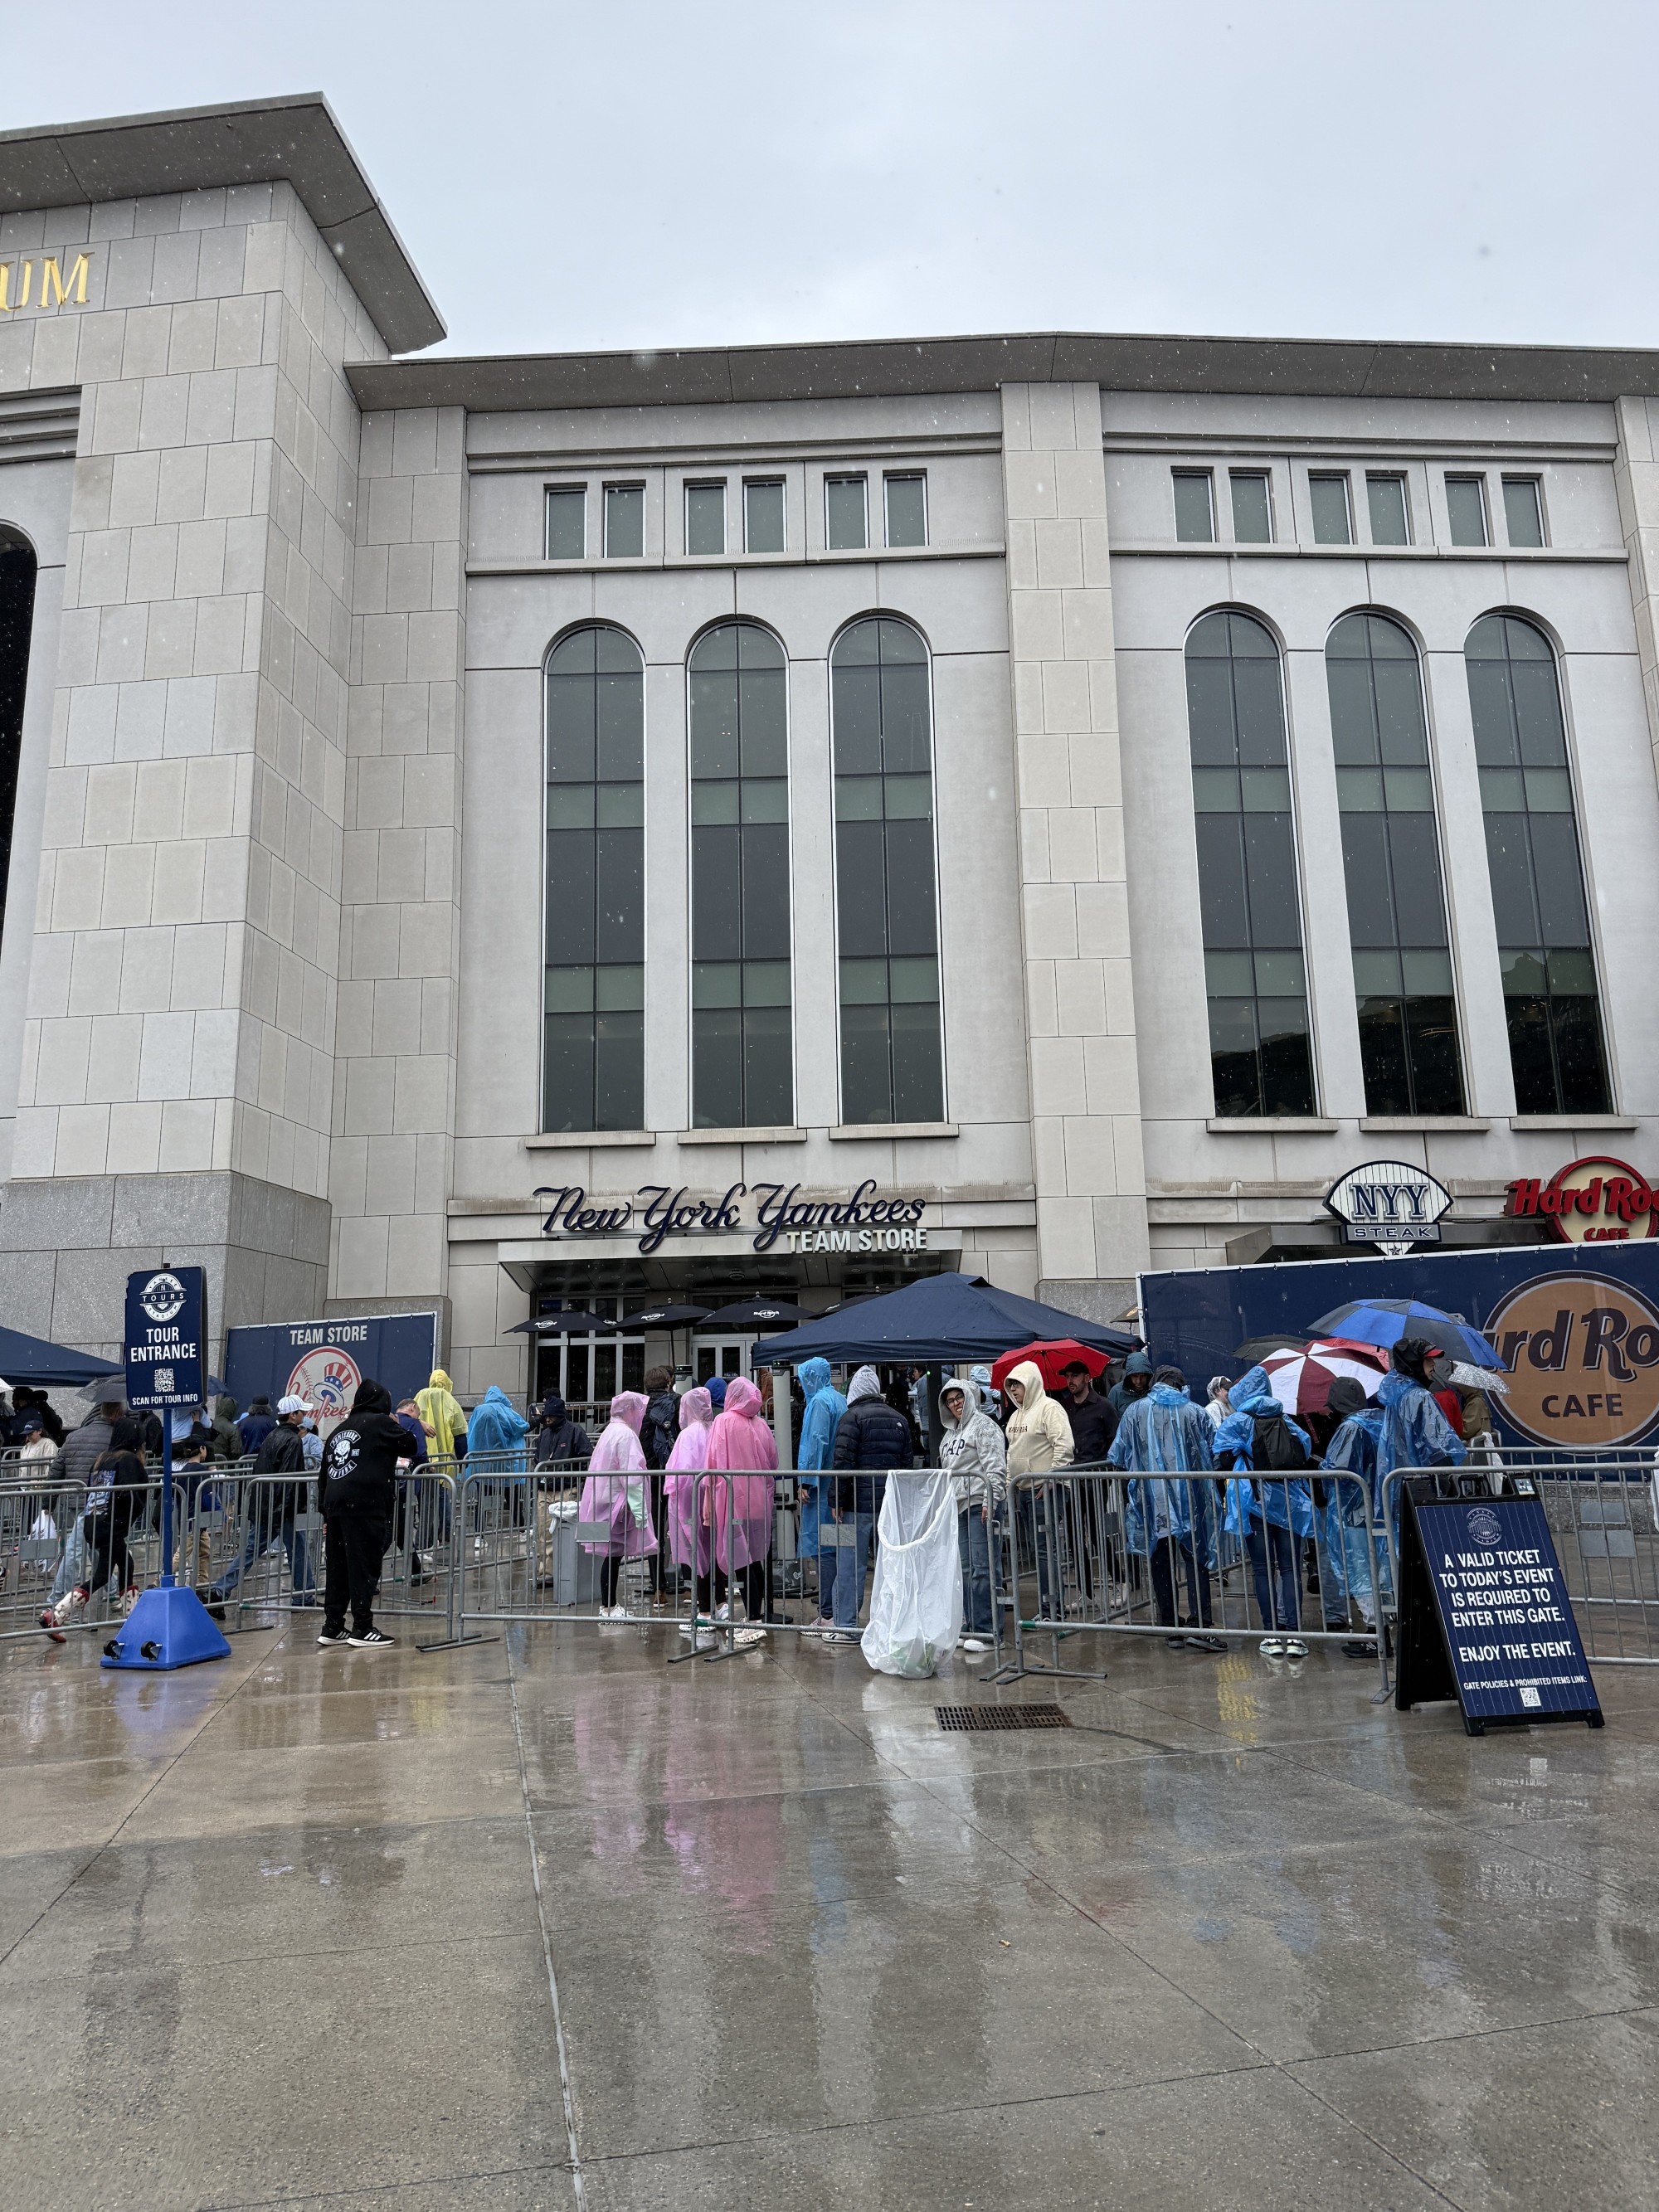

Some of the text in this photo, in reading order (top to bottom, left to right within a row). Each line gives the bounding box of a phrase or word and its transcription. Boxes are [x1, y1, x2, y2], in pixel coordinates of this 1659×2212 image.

[1349, 1182, 1429, 1219] NYY
[1503, 1177, 1603, 1215] Hard
[533, 1179, 926, 1253] New York Yankees
[786, 1228, 927, 1253] TEAM STORE
[1353, 1226, 1435, 1239] STEAK
[1584, 1228, 1630, 1241] CAFE
[142, 1292, 184, 1303] TOURS
[148, 1305, 178, 1319] STADIUM
[146, 1326, 179, 1344] TOUR
[290, 1325, 367, 1345] TEAM STORE
[1483, 1310, 1574, 1373] rd
[130, 1343, 197, 1363] ENTRANCE
[132, 1393, 198, 1406] SCAN FOR TOUR INFO
[1541, 1393, 1623, 1418] CAFE
[1445, 1549, 1540, 1568] A VALID TICKET
[1439, 1568, 1554, 1588] TO TODAY'S EVENT
[1451, 1587, 1551, 1607] IS REQUIRED TO
[1452, 1607, 1565, 1627] ENTER THIS GATE.
[1459, 1641, 1576, 1662] ENJOY THE EVENT.
[1463, 1681, 1480, 1690] GATE
[1480, 1680, 1508, 1689] POLICIES
[1515, 1677, 1551, 1686] PROHIBITED
[1551, 1676, 1570, 1685] ITEMS
[1570, 1675, 1588, 1684] LINK:
